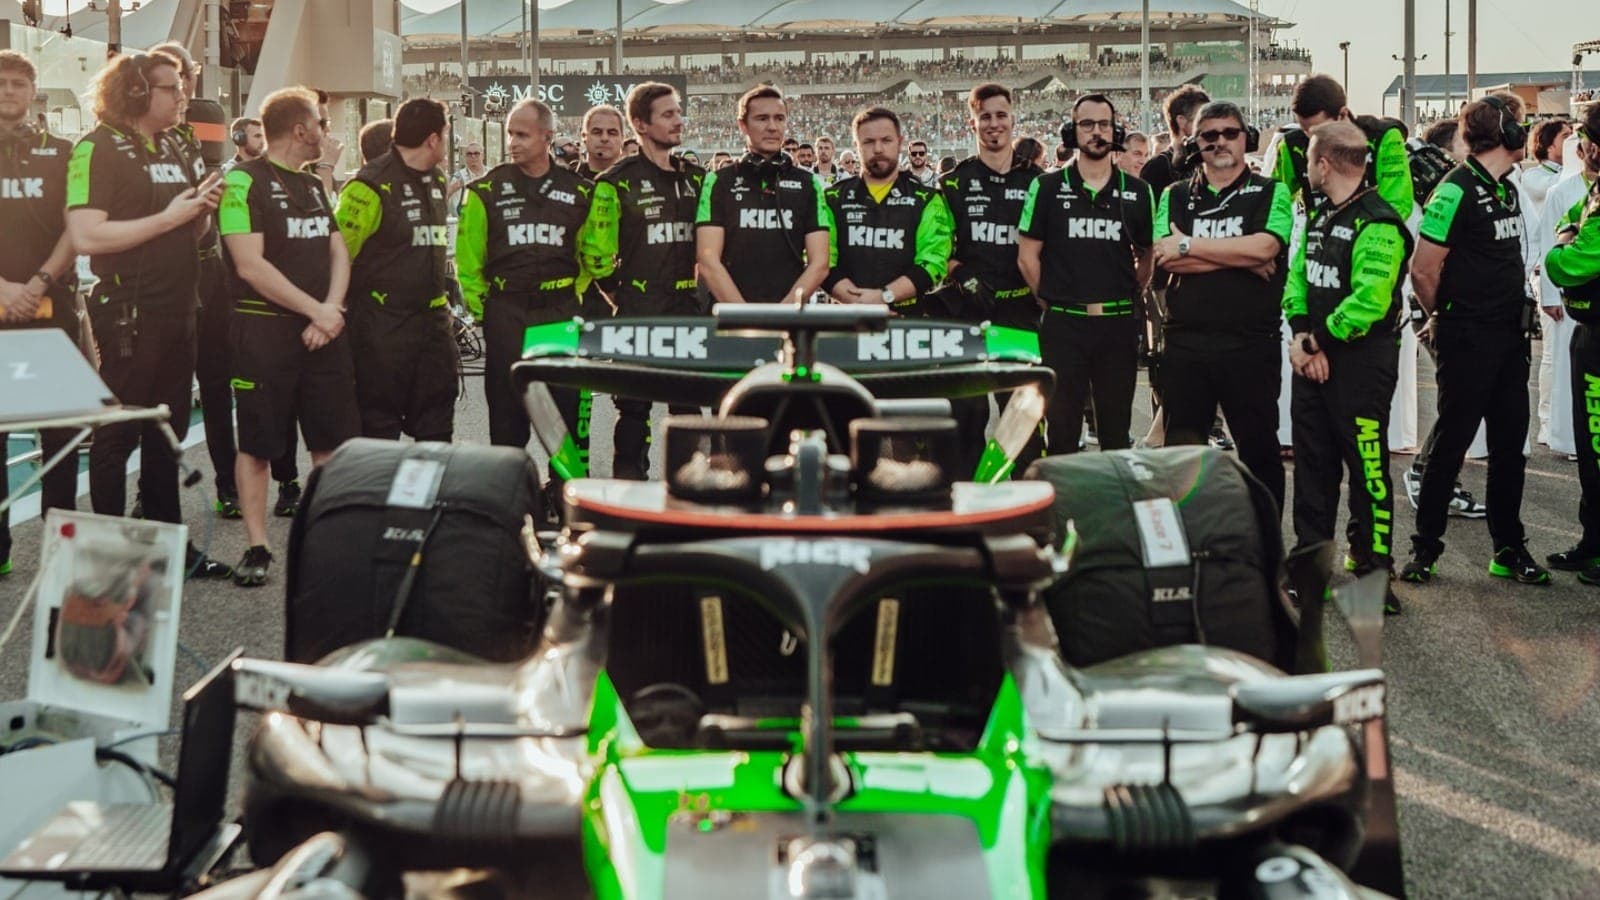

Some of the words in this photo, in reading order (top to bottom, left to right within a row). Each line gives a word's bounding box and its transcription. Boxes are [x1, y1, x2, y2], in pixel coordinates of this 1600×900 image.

[740, 208, 793, 230] KICK
[1068, 217, 1122, 242] KICK
[1193, 216, 1243, 239] KICK
[507, 223, 566, 247] KICK
[848, 225, 905, 250] KICK
[601, 325, 708, 360] KICK
[857, 327, 964, 361] KICK
[1355, 416, 1388, 501] CREW
[1372, 503, 1391, 555] PIT
[760, 539, 872, 575] KICK
